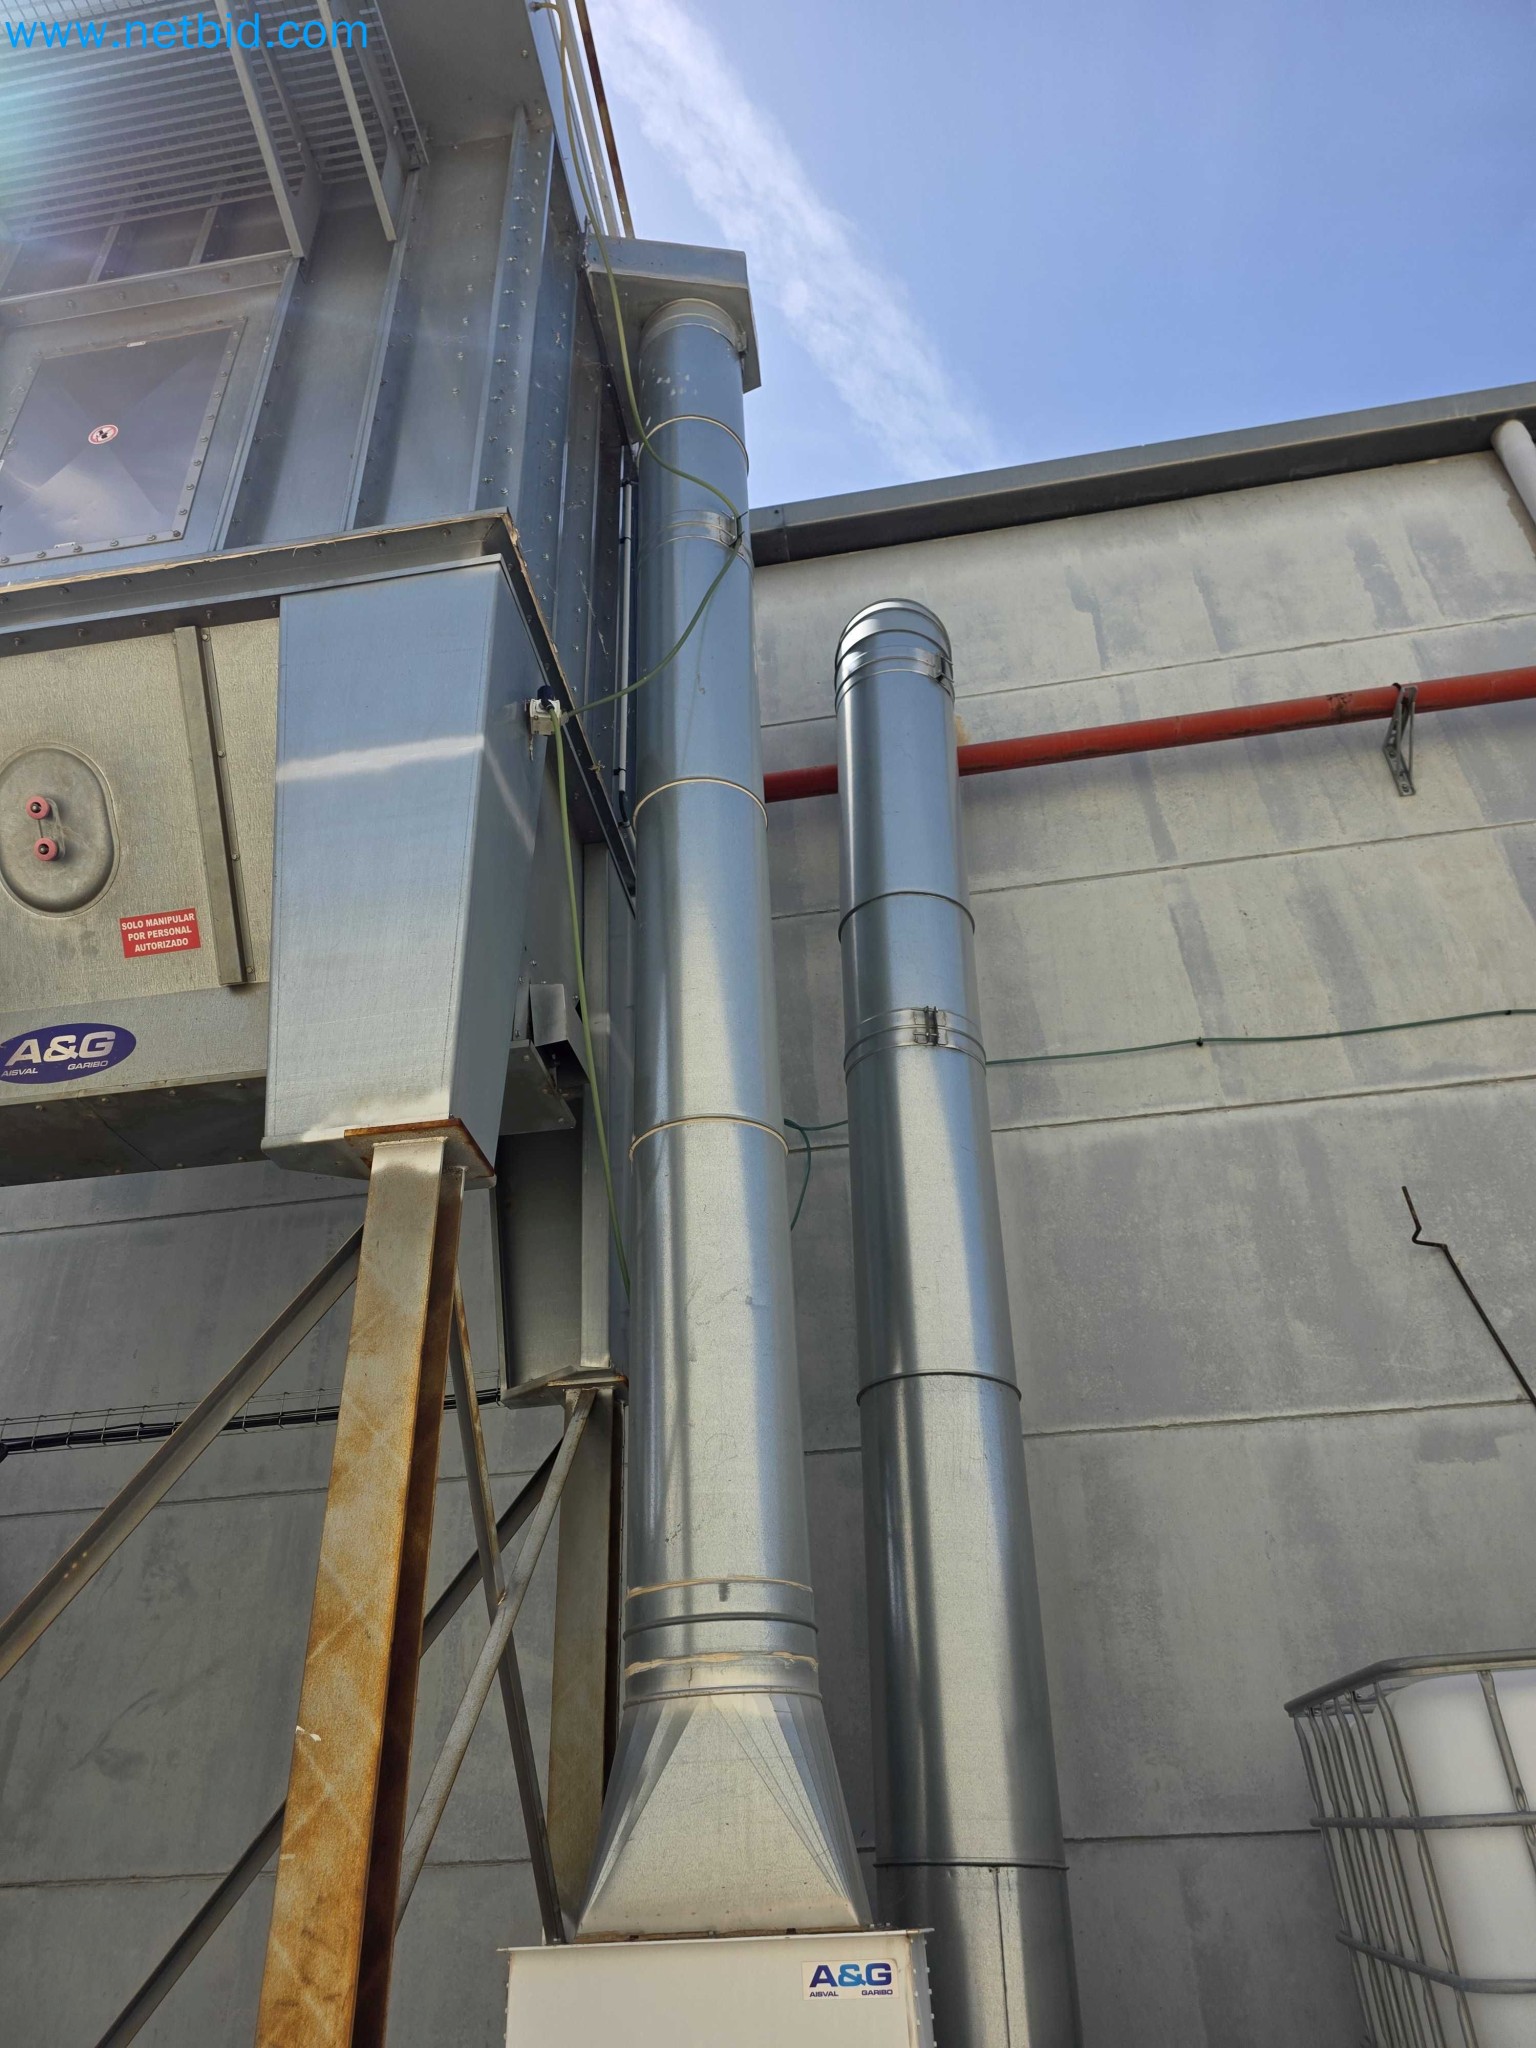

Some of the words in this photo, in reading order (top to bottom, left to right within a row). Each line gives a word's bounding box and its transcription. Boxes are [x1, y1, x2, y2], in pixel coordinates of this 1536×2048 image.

[121, 920, 144, 931] SOLO
[145, 912, 195, 927] MANIPULAR
[127, 932, 146, 942] POR
[147, 925, 192, 939] PERSONAL
[134, 937, 189, 953] AUTORIZADO
[4, 1031, 116, 1067] A&G
[1, 1067, 39, 1077] AISVAL
[67, 1060, 109, 1071] GARIBO
[809, 1962, 892, 1988] A&G
[809, 1990, 839, 1998] AISVAL
